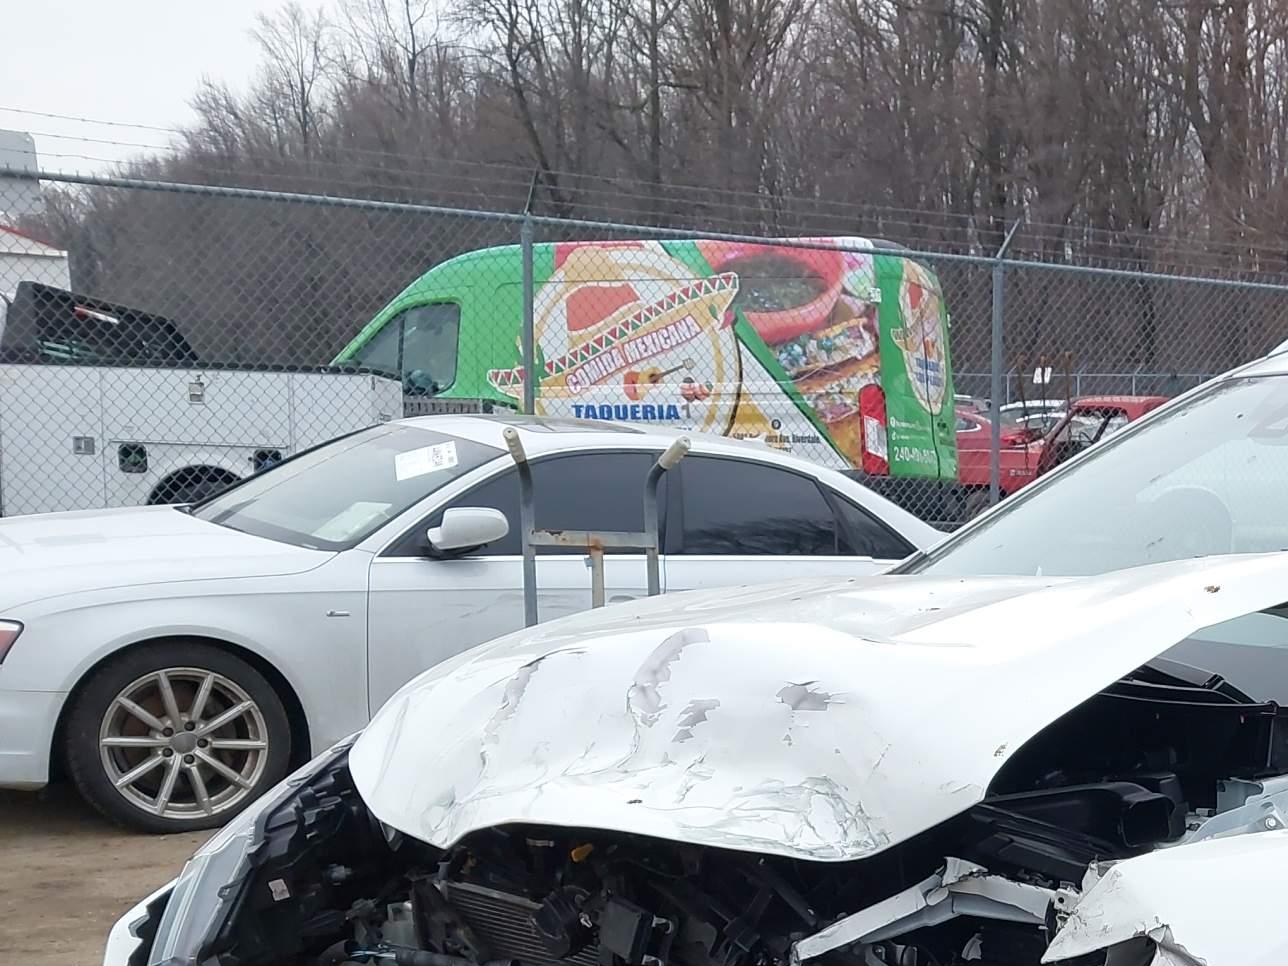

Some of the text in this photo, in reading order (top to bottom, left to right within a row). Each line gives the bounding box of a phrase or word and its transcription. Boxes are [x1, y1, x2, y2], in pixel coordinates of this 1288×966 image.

[566, 315, 702, 394] COMIDA MEXICANA
[571, 404, 681, 420] TAQUERIA
